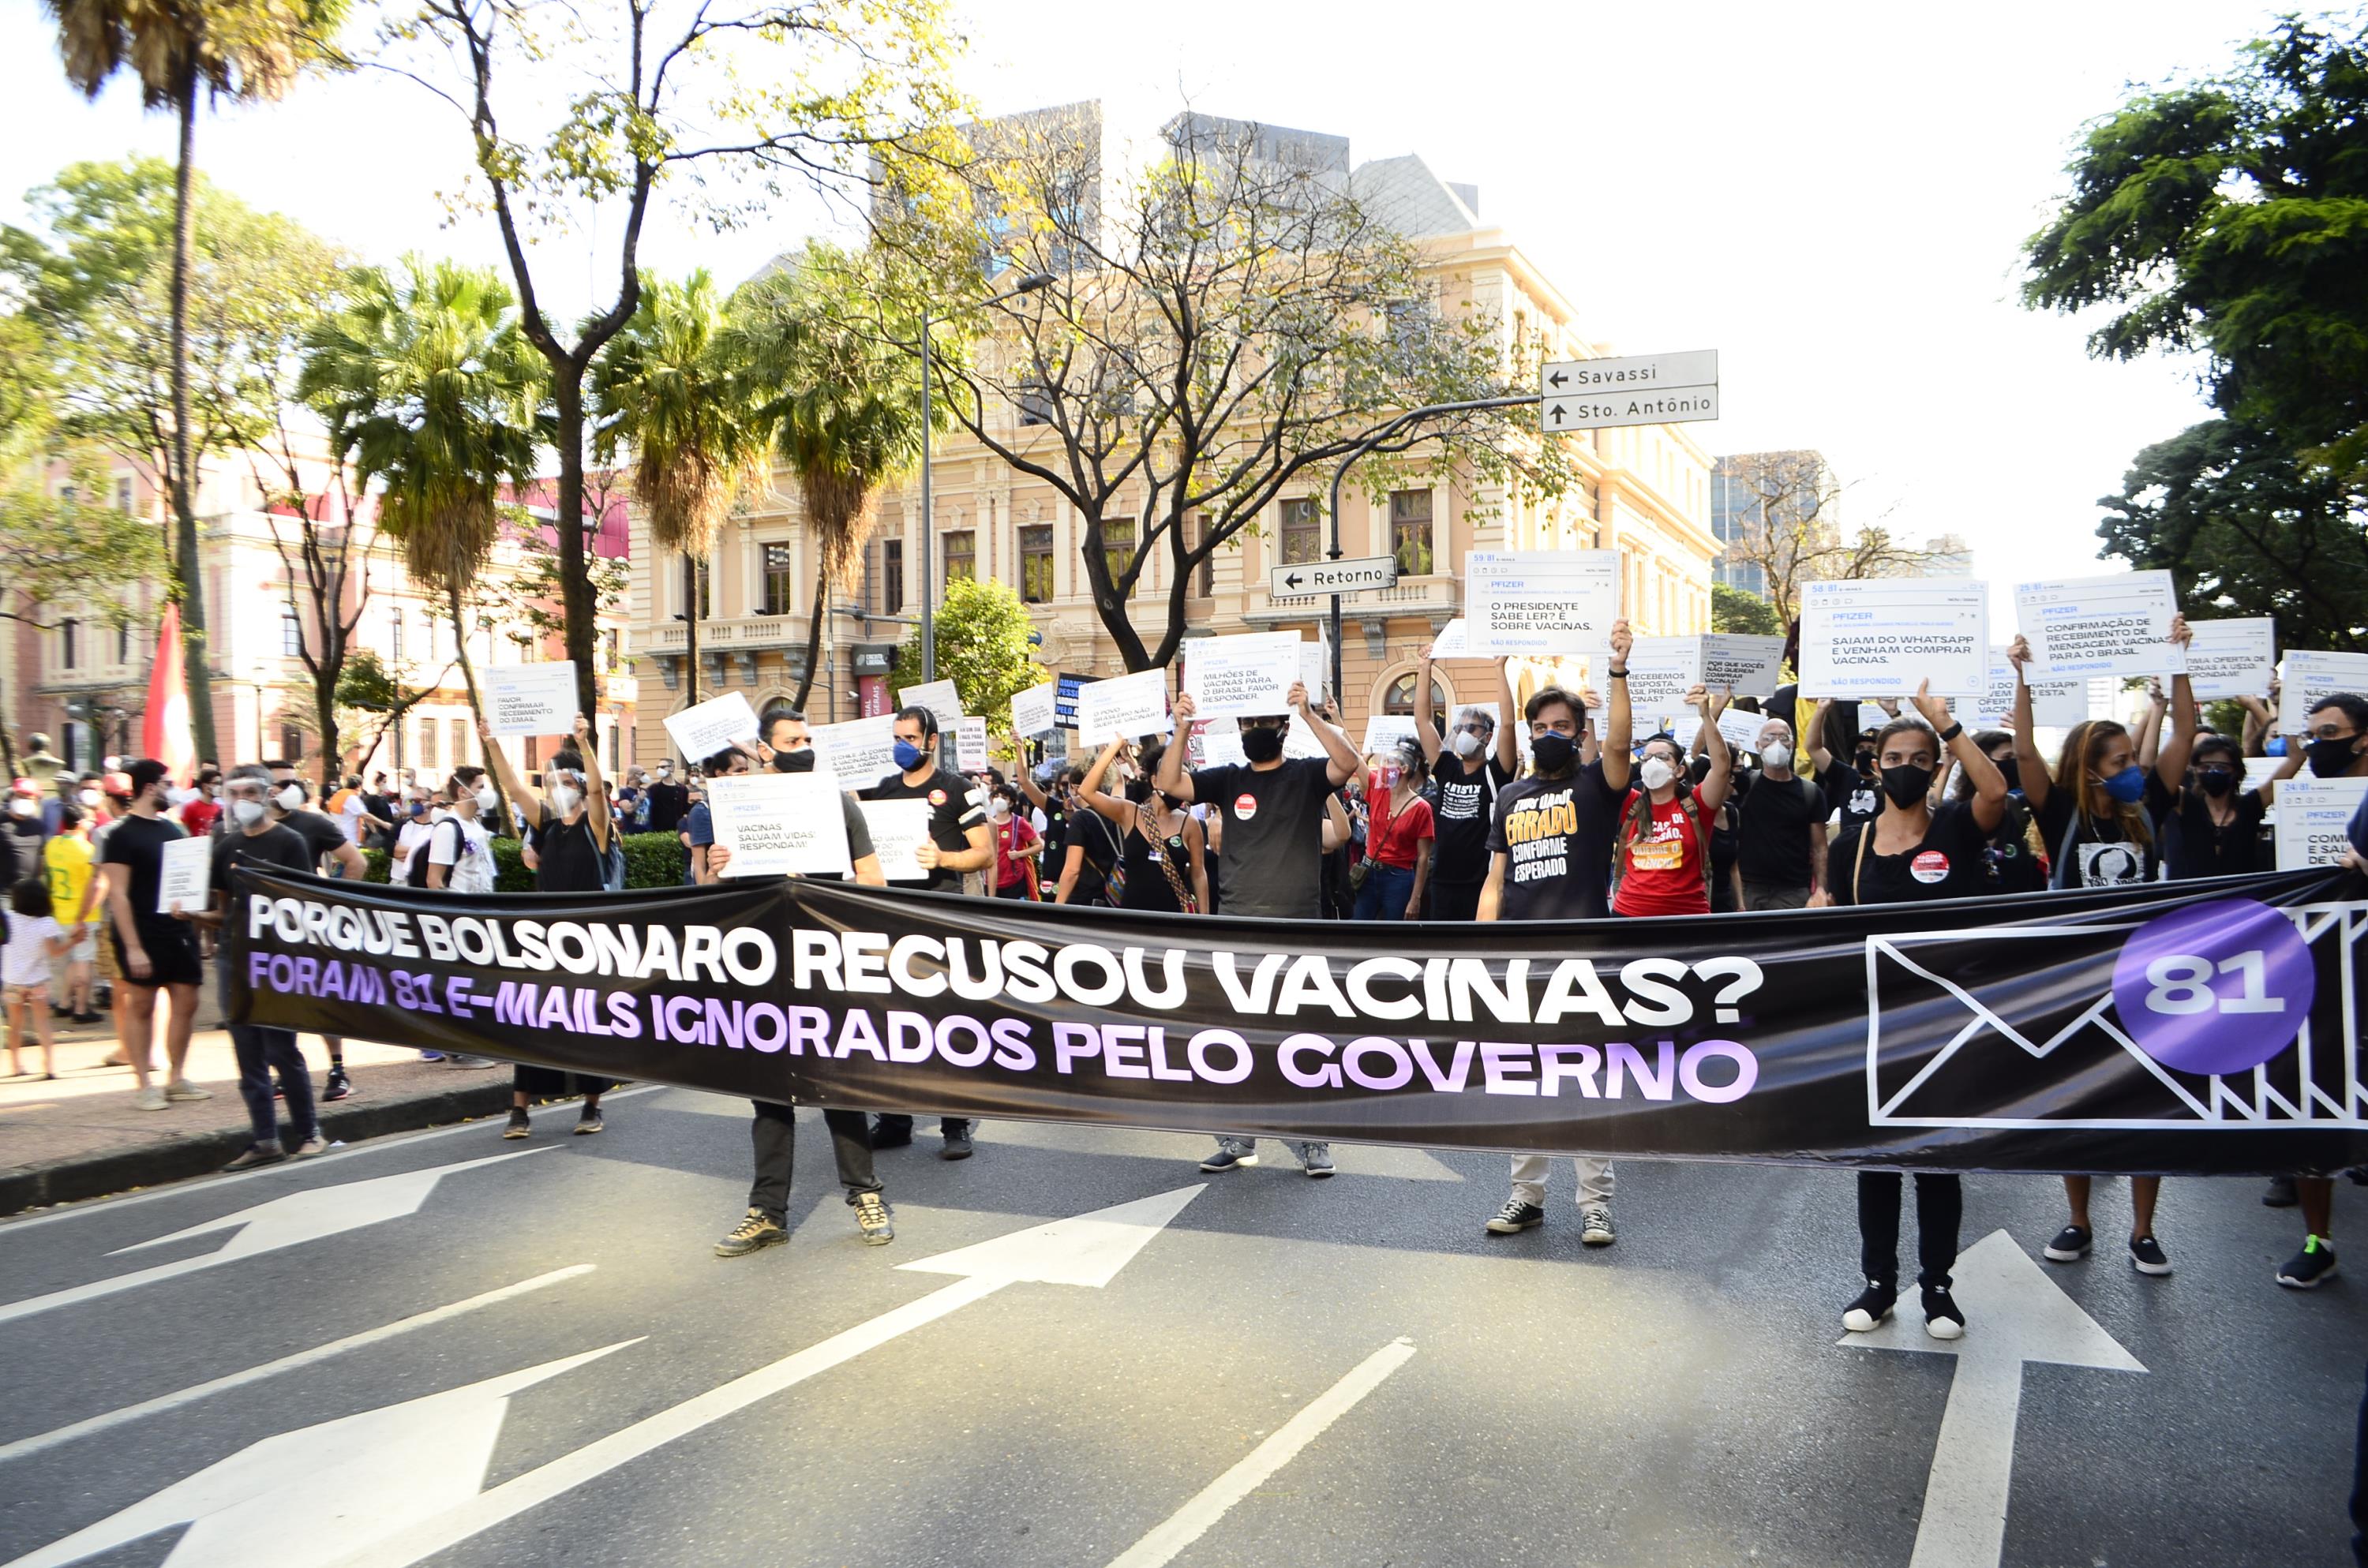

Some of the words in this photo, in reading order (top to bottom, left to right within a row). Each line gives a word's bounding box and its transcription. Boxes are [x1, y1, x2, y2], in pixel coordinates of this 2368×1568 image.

[1579, 364, 1657, 384] Savassi
[1578, 405, 1617, 419] Sto.
[1627, 396, 1710, 415] Antônio
[1314, 570, 1382, 586] Retorno
[1491, 602, 1501, 611] O
[1504, 602, 1579, 611] PRESIDENTE
[2042, 606, 2078, 615] PFIZER
[1491, 612, 1524, 620] SABE
[1527, 612, 1556, 620] LER?
[1559, 609, 1566, 620] É
[1491, 622, 1531, 631] SOBRE
[1535, 622, 1593, 631] VACINAS.
[2045, 618, 2133, 633] CONFIRMAÇÃO
[1832, 636, 1875, 645] SAIAM
[2047, 629, 2131, 642] RECEBIMENTO
[2048, 640, 2119, 651] MENSAGEM:
[2050, 652, 2083, 661] PARA
[2051, 662, 2066, 672] NÃO
[2068, 661, 2112, 671] RESPONDIDO
[1204, 669, 1244, 680] MILHÕES
[1203, 679, 1243, 687] VACINAS
[1831, 677, 1848, 686] NÃO
[1248, 683, 1279, 692] FAVOR
[2304, 688, 2329, 697] NÃO
[1202, 693, 1259, 703] RESPONDER.
[1093, 710, 1133, 724] BRASILEIRO
[1124, 712, 1160, 722] VACINAR?
[837, 767, 874, 777] ESPONDEU.
[1505, 800, 1577, 847] ERRADO
[1671, 813, 1684, 824] DE
[736, 824, 782, 833] VACINAS
[738, 833, 781, 841] SALVAM
[740, 841, 808, 851] RESPONDAM!
[1512, 837, 1568, 863] CONFORME
[1672, 844, 1680, 853] O
[2308, 845, 2316, 854] E
[1515, 857, 1567, 882] ESPERADO
[2088, 876, 2109, 887] 130
[249, 893, 421, 958] PORQUE
[418, 914, 777, 986] BOLSONARO
[792, 928, 1187, 1009] RECUSOU
[1212, 951, 1764, 1026] VACINAS?
[2145, 949, 2284, 1015] 81
[249, 952, 388, 1005] FORAM
[390, 970, 442, 1014] 81
[446, 978, 640, 1038] E-MAILS
[650, 994, 1036, 1071] IGNORADOS
[1052, 1022, 1254, 1084] PELO
[1277, 1032, 1759, 1105] GOVERNO
